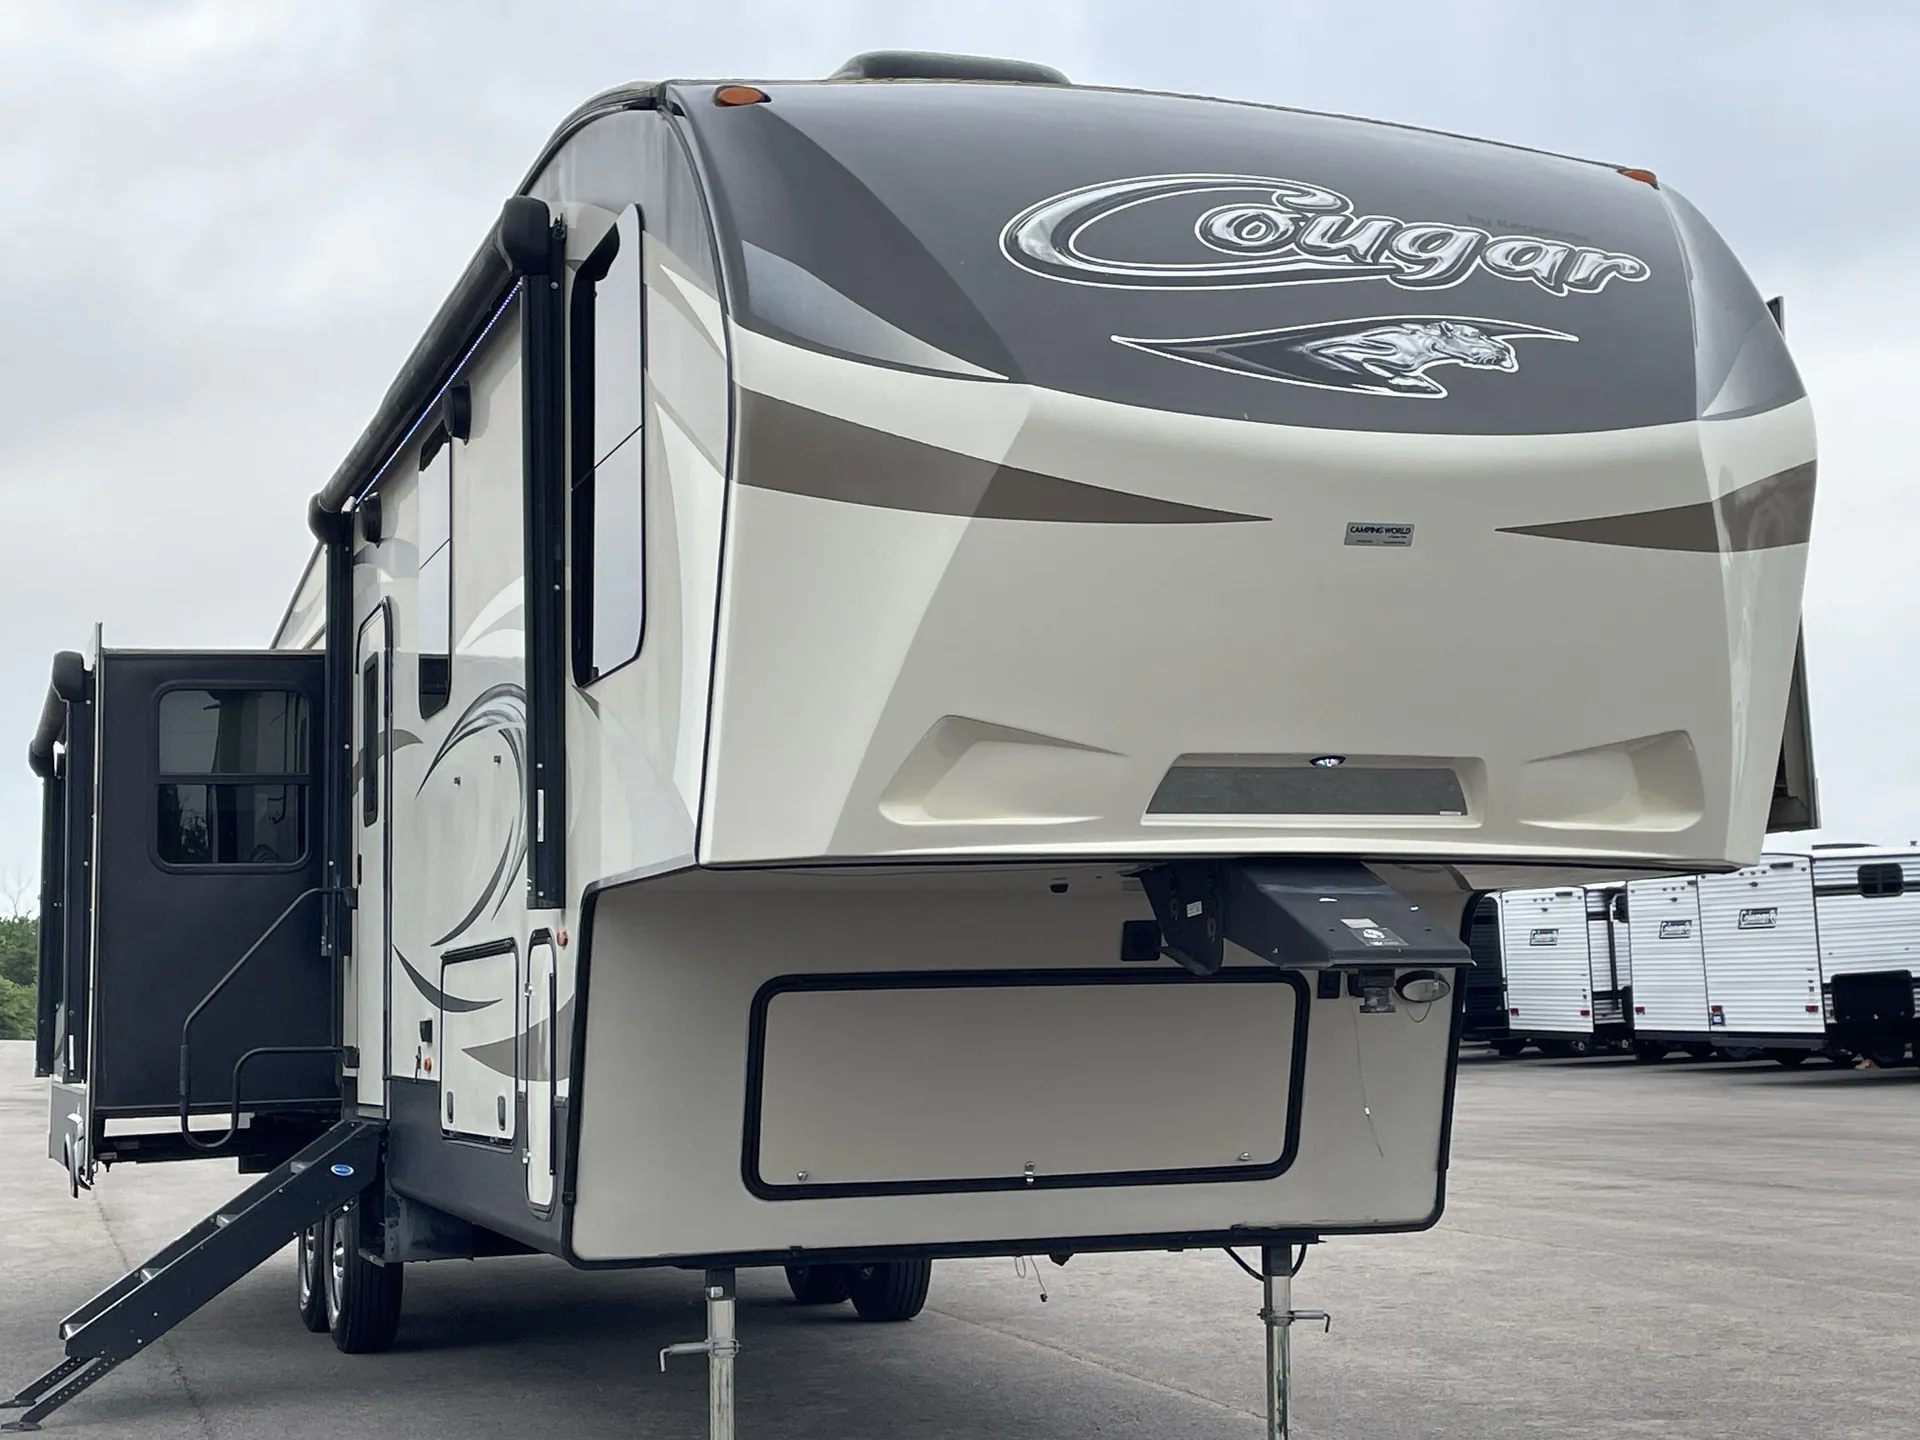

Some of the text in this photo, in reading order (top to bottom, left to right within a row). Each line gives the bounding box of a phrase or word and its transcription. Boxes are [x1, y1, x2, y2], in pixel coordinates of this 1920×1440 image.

[1000, 173, 1651, 295] Cougar
[1350, 526, 1411, 535] CAMPING WORLD
